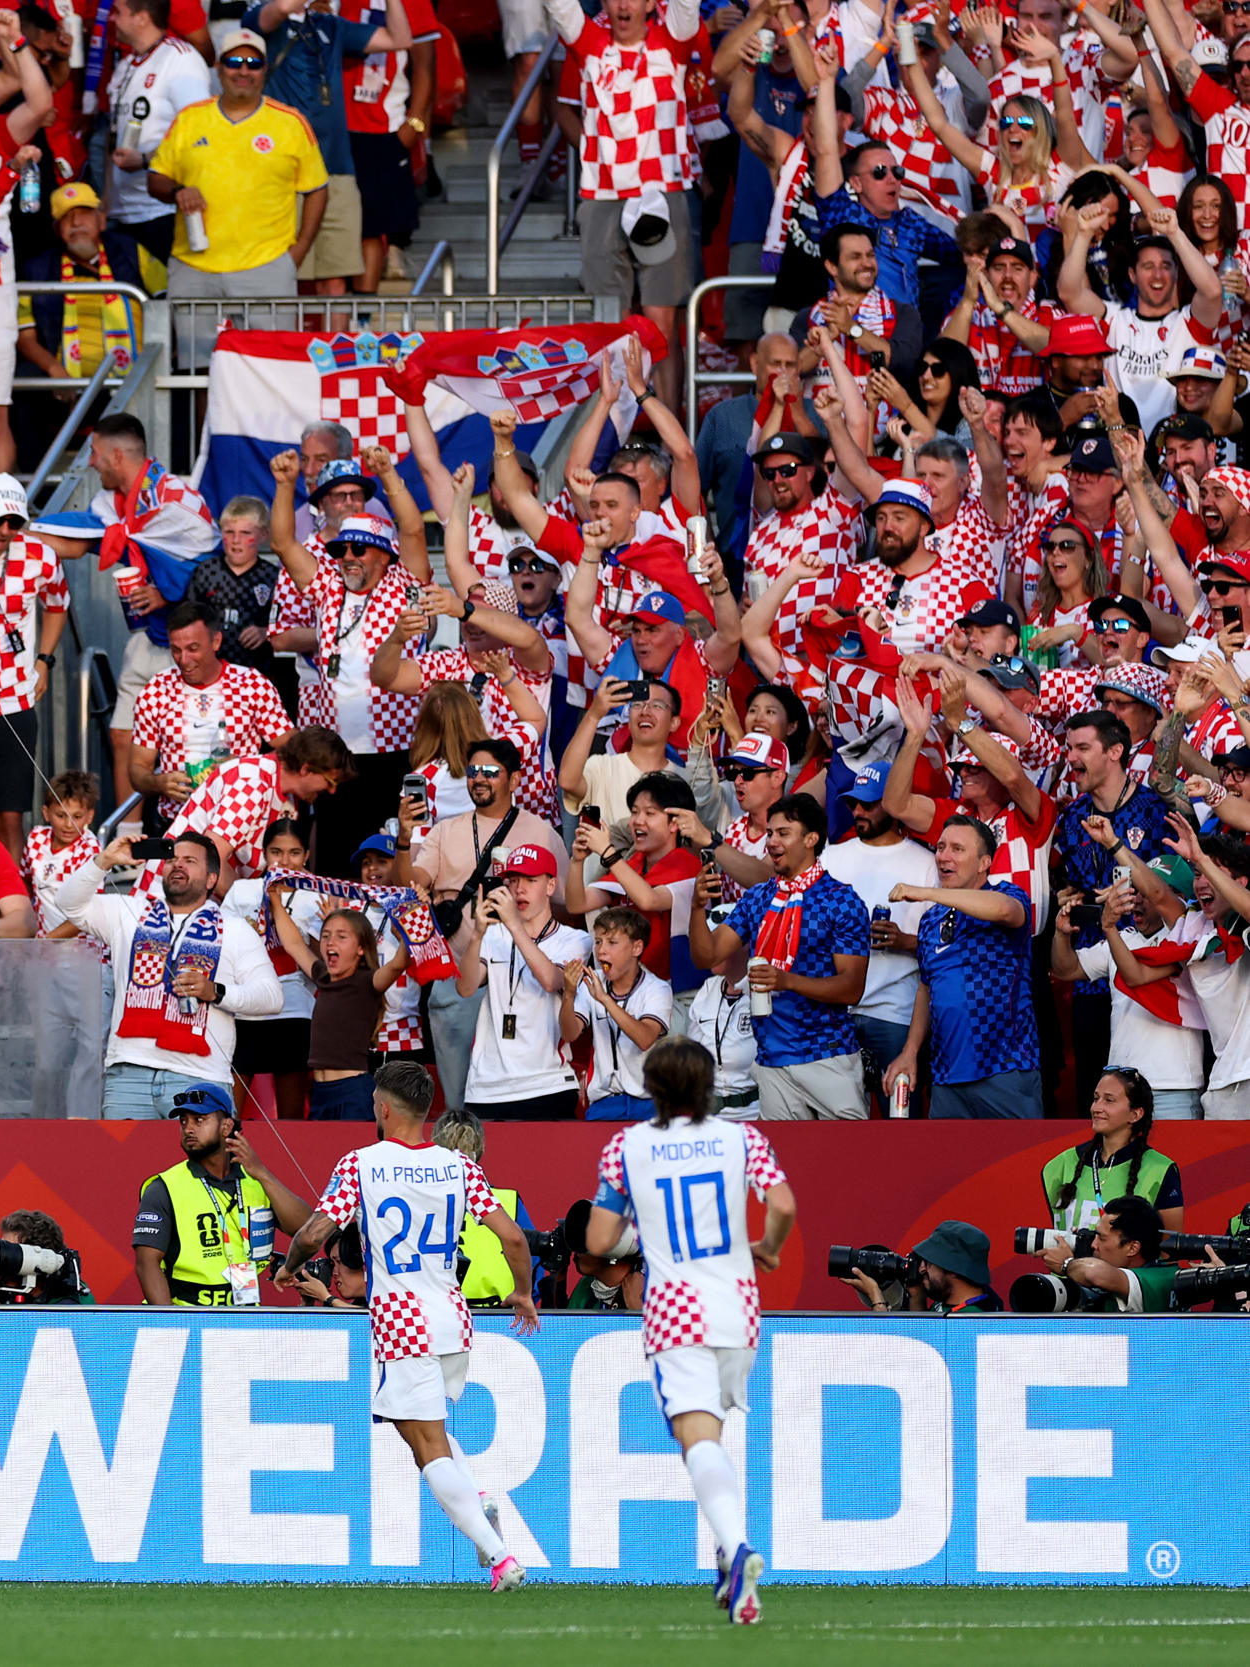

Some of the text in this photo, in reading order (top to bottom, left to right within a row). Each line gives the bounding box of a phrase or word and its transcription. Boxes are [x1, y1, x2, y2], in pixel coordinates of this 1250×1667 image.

[372, 1163, 459, 1184] M. PAŠALIĆ
[652, 1137, 725, 1162] MODRIĆ
[376, 1193, 456, 1275] 24
[654, 1171, 732, 1264] 10
